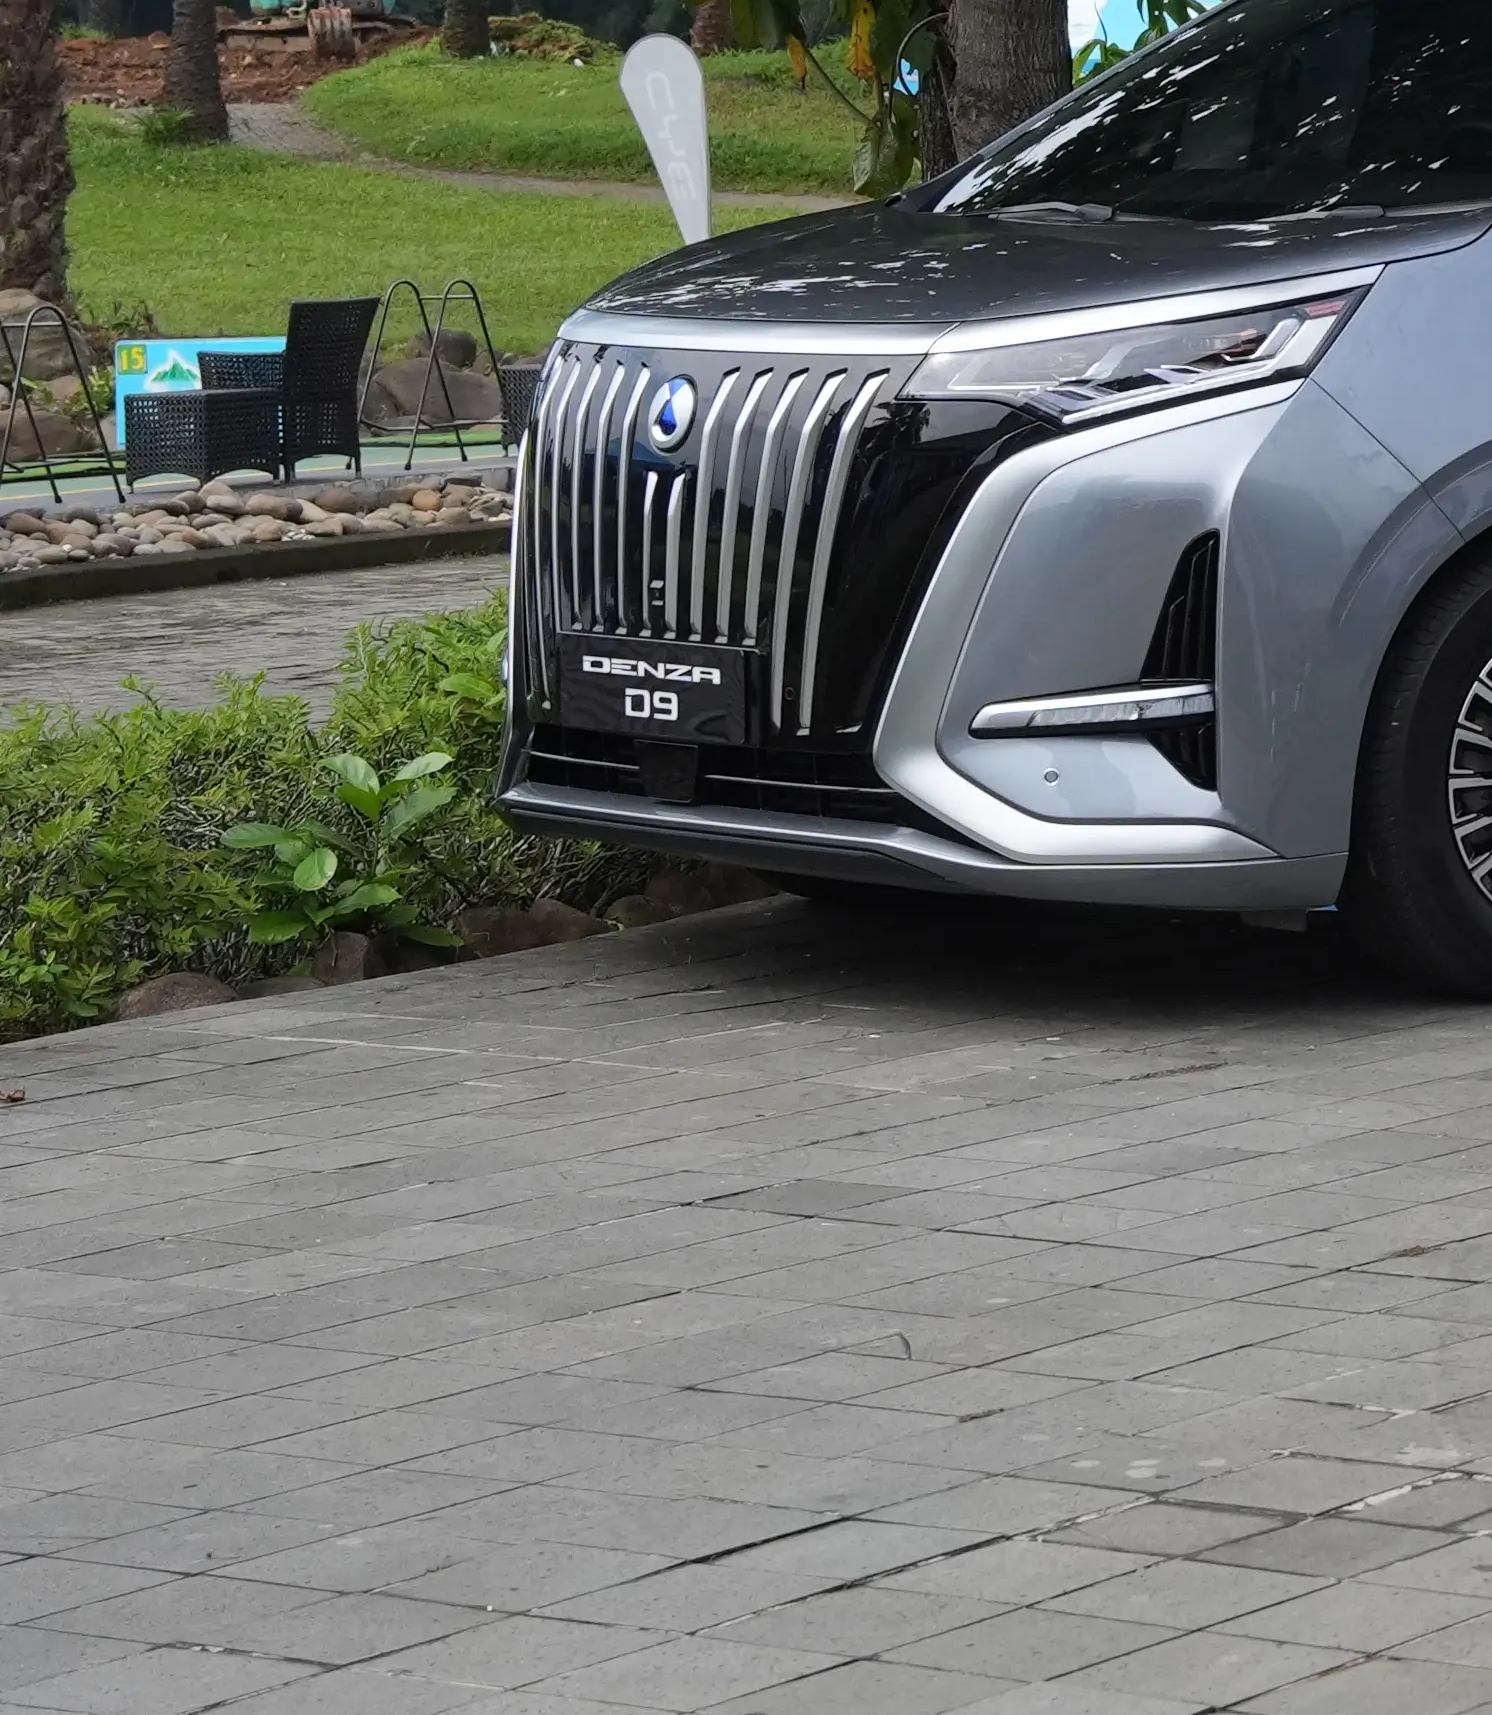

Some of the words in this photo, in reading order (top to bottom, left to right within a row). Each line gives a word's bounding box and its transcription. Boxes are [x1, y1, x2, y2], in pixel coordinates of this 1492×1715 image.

[119, 346, 145, 371] 15
[582, 655, 721, 685] DENZA
[625, 687, 679, 721] D9
